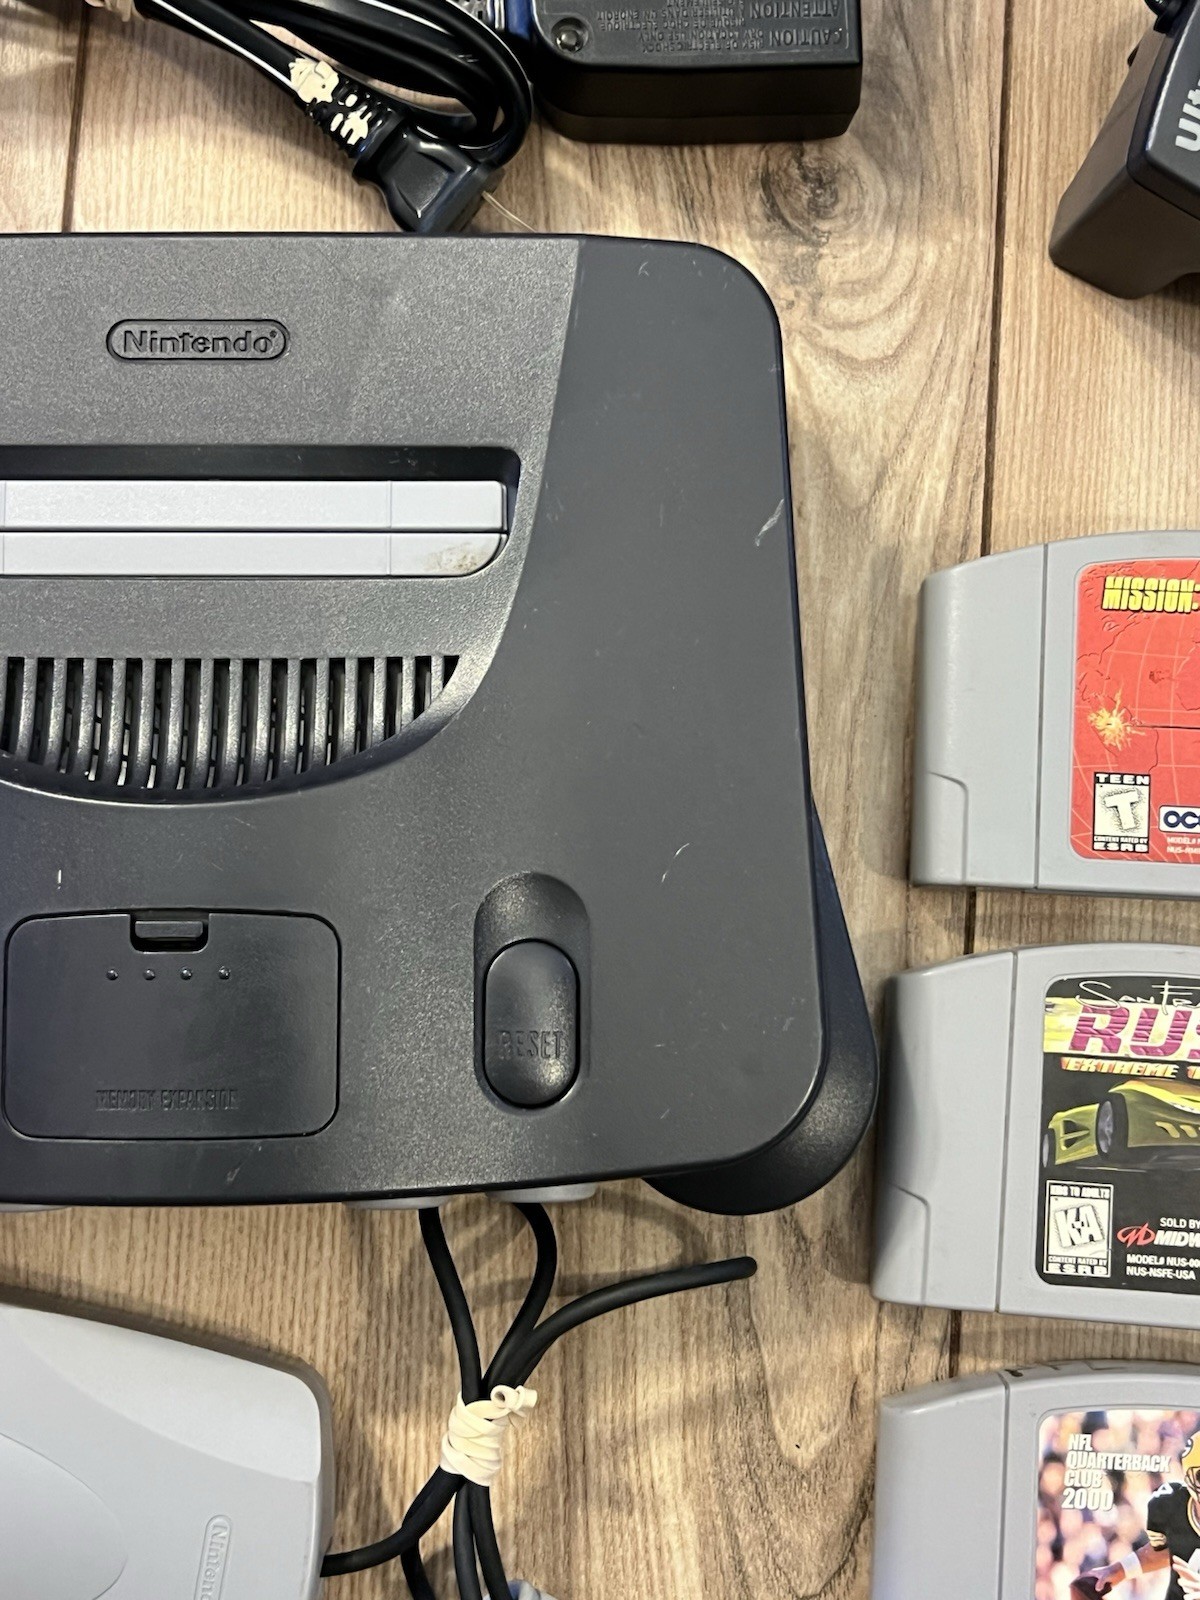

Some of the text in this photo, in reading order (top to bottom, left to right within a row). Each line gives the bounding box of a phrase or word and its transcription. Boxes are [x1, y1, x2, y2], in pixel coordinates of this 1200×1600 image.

[748, 0, 840, 18] ATTENTION
[768, 28, 842, 46] CAUTION
[1175, 79, 1200, 151] Ult
[124, 329, 274, 353] Nintendo
[1095, 773, 1150, 785] TEEN
[1163, 810, 1200, 829] OC
[1093, 842, 1148, 853] ESRB
[1068, 1006, 1200, 1060] RU
[496, 1030, 564, 1060] RESET
[1060, 1057, 1180, 1078] EXTREME
[96, 1089, 239, 1112] MEMORY EXPANSION
[1159, 1217, 1200, 1229] SOLD BY
[1047, 1263, 1108, 1275] ESRB
[1126, 1265, 1196, 1281] NUS-NSFE-USA
[1068, 1433, 1093, 1452] NFL
[1065, 1451, 1171, 1473] QUARTERBACK
[1064, 1469, 1103, 1488] CLUB
[1061, 1487, 1114, 1511] 2000
